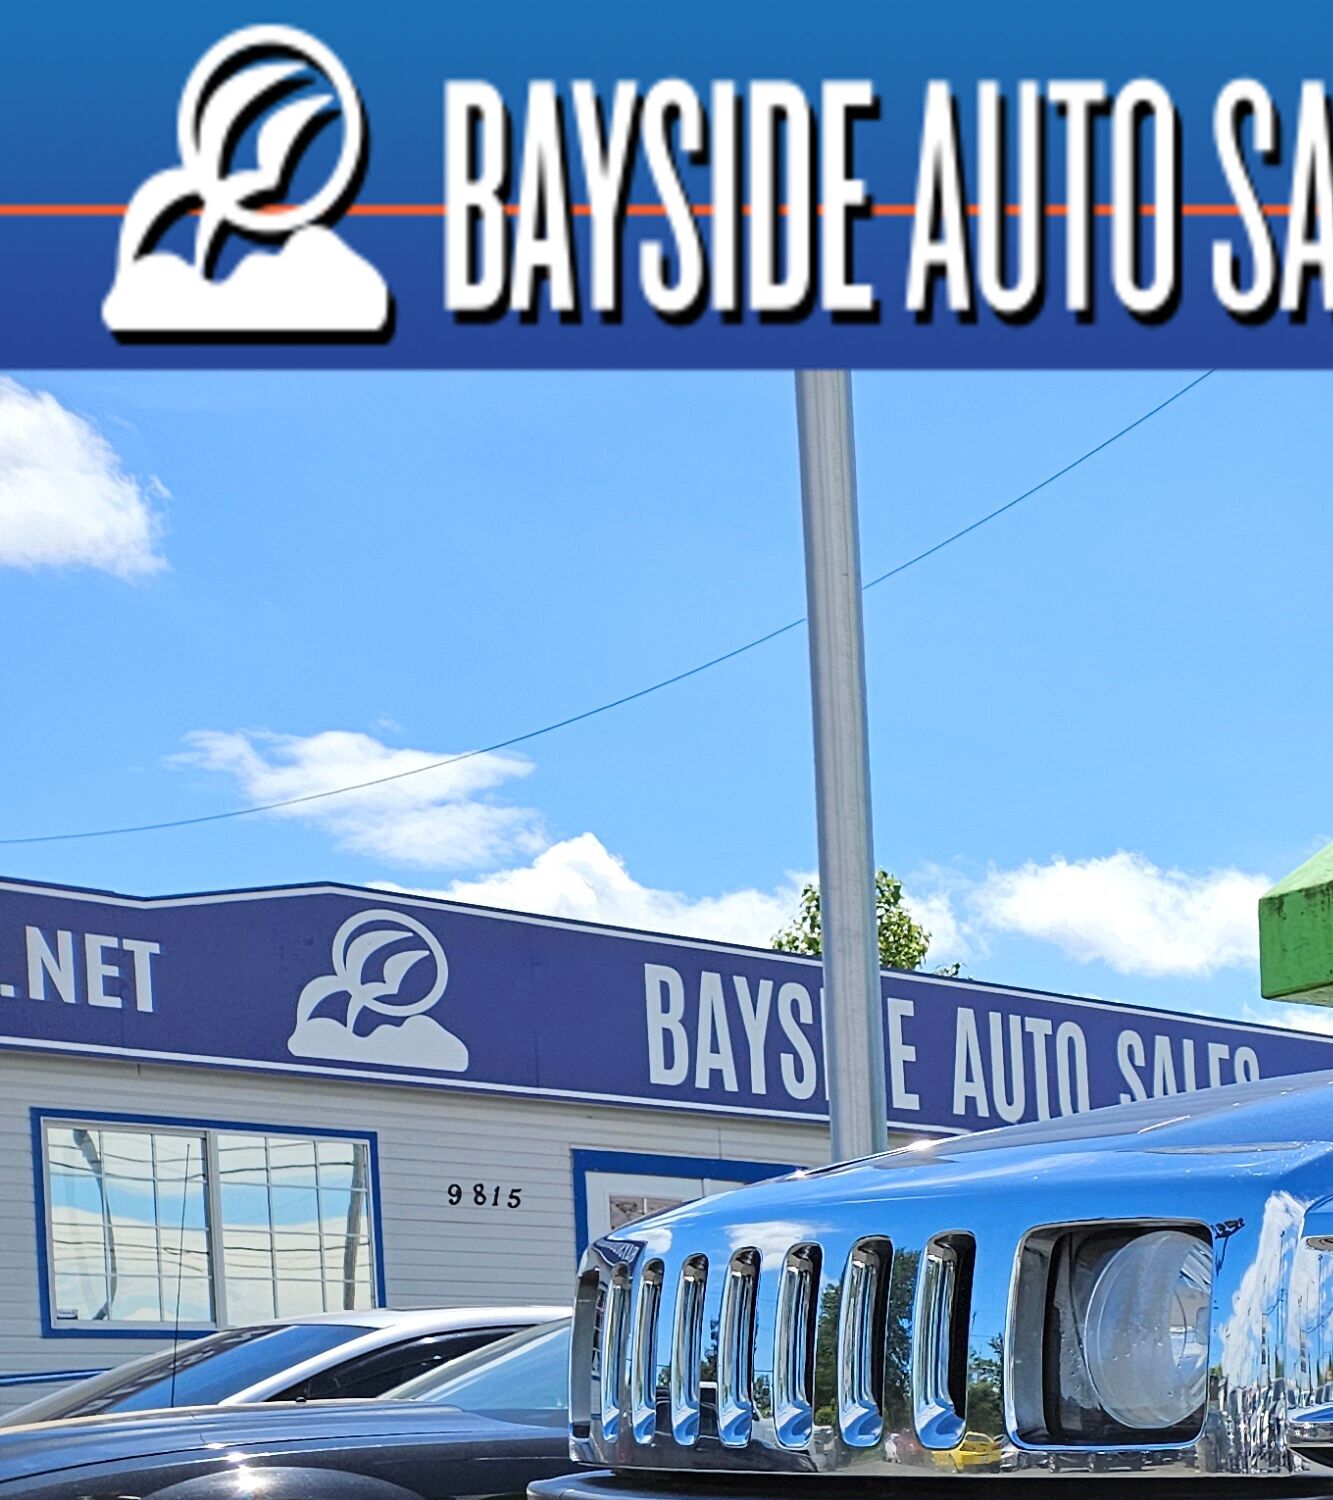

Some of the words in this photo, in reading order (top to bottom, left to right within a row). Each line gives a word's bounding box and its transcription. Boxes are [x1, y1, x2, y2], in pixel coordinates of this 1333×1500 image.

[644, 963, 920, 1111] BAYSE
[953, 1007, 1091, 1124] AUTO
[447, 1183, 522, 1209] 9815
